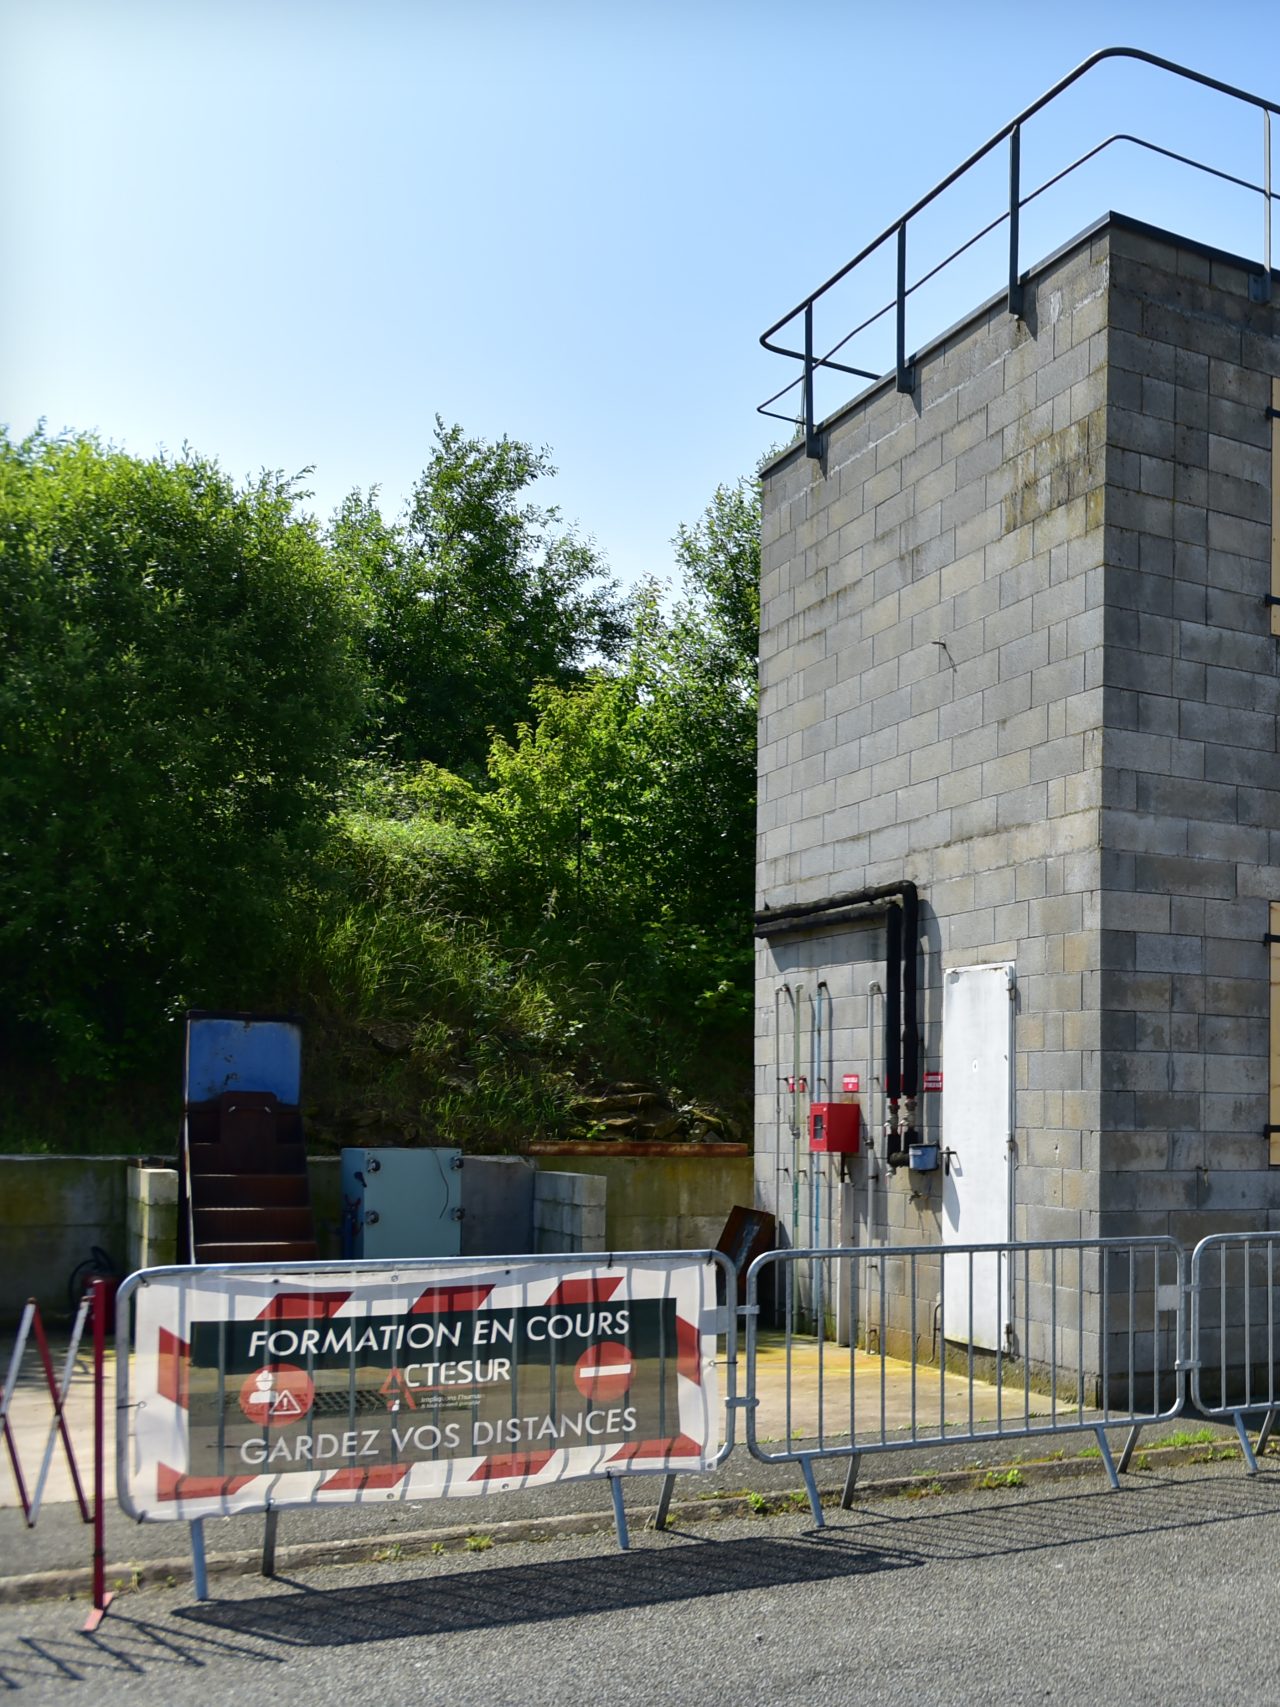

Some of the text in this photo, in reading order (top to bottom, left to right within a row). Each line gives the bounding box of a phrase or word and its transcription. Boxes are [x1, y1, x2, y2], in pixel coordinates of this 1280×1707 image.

[248, 1310, 630, 1357] FORMATION EN COURS
[240, 1407, 637, 1464] GARDEZ VOS DISTANCES
